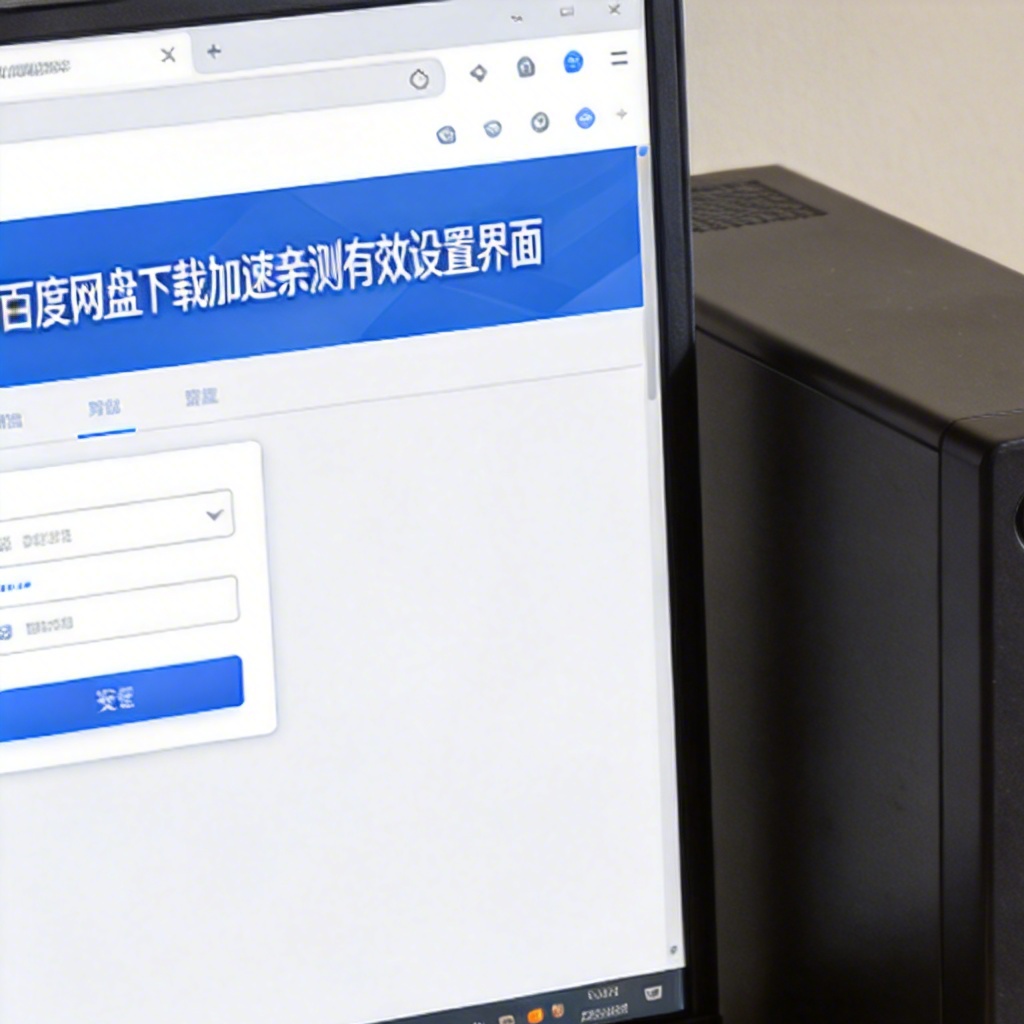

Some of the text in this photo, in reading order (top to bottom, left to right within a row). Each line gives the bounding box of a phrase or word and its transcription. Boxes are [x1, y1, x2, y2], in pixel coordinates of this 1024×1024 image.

[0, 218, 542, 332] 百度网盘下载加速亲测有效设置界面
